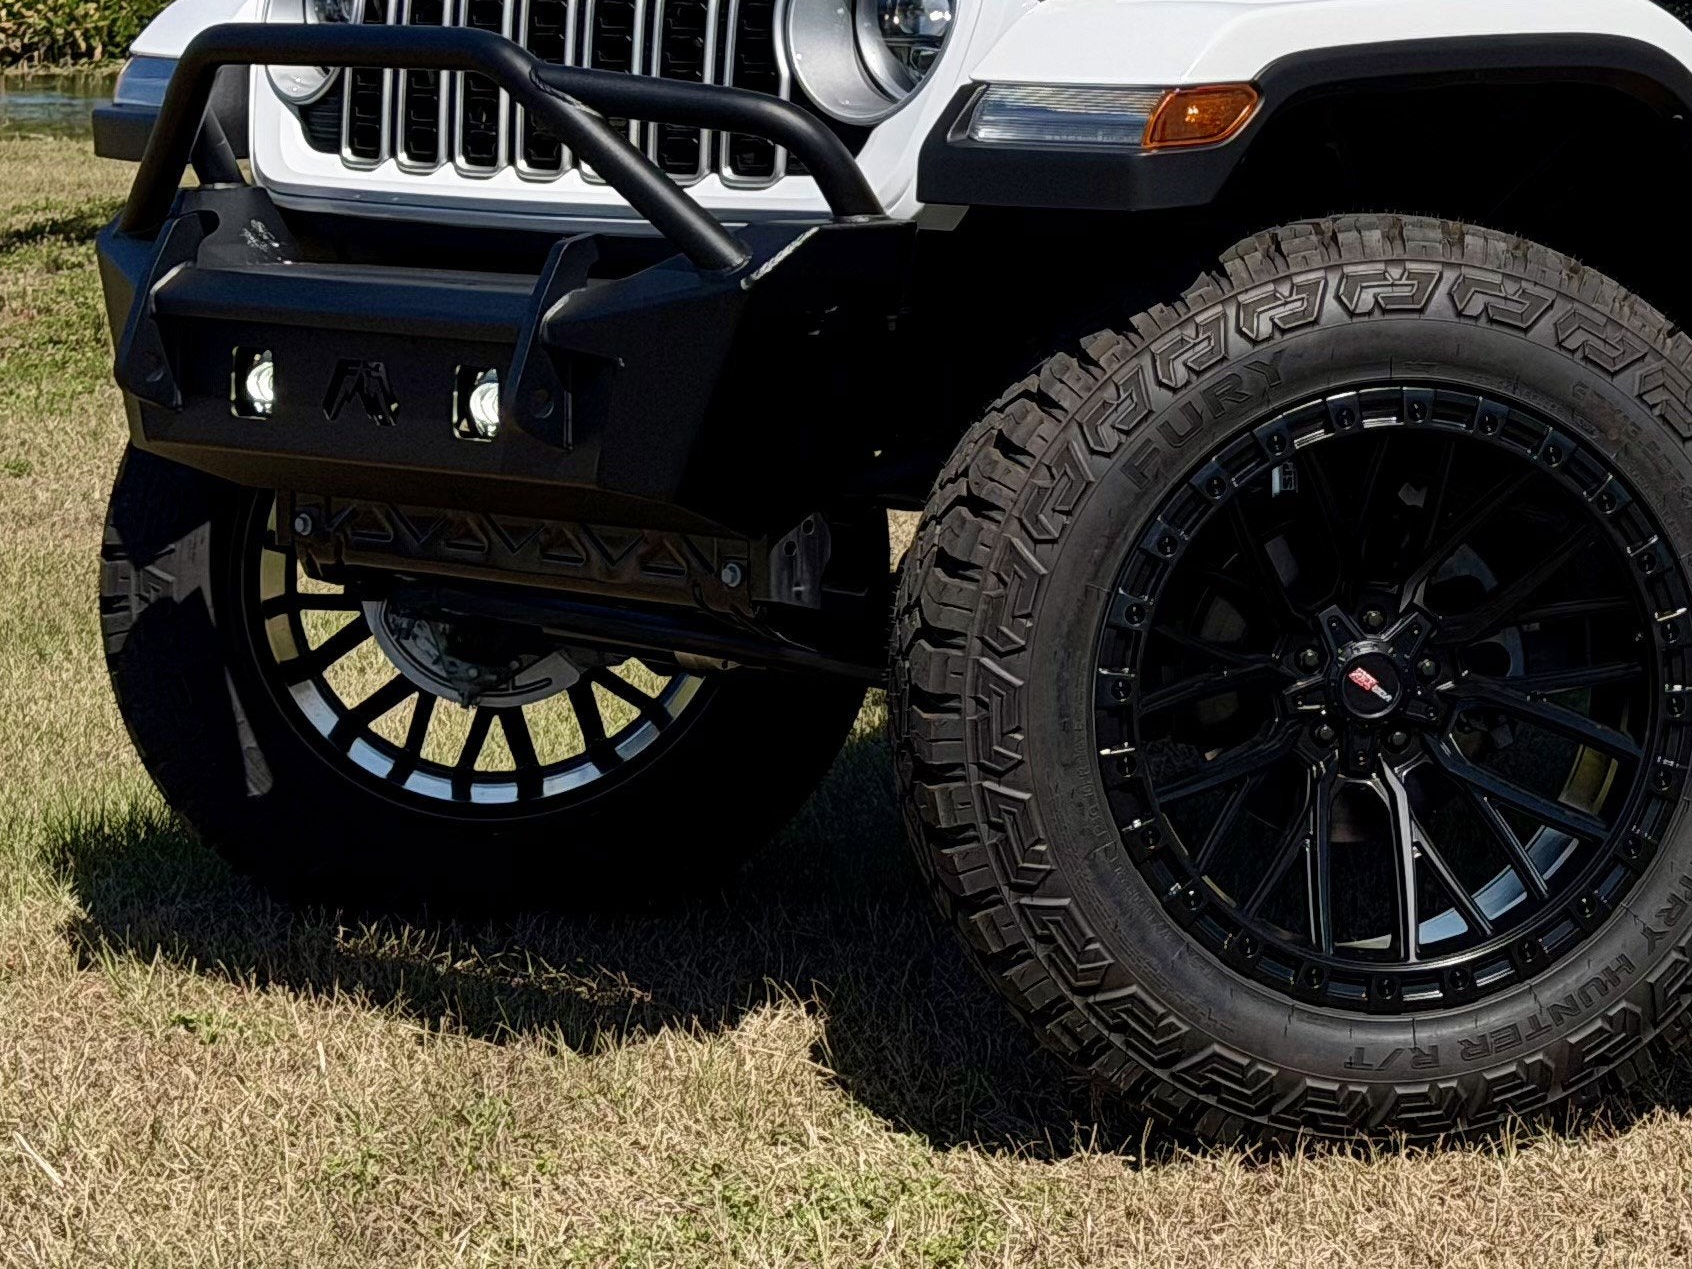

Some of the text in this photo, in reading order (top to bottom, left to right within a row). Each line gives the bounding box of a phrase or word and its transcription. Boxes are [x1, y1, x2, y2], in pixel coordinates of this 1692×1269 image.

[1120, 350, 1285, 490] FURY
[1344, 1045, 1440, 1071] R/T
[1458, 954, 1639, 1062] HUNTER
